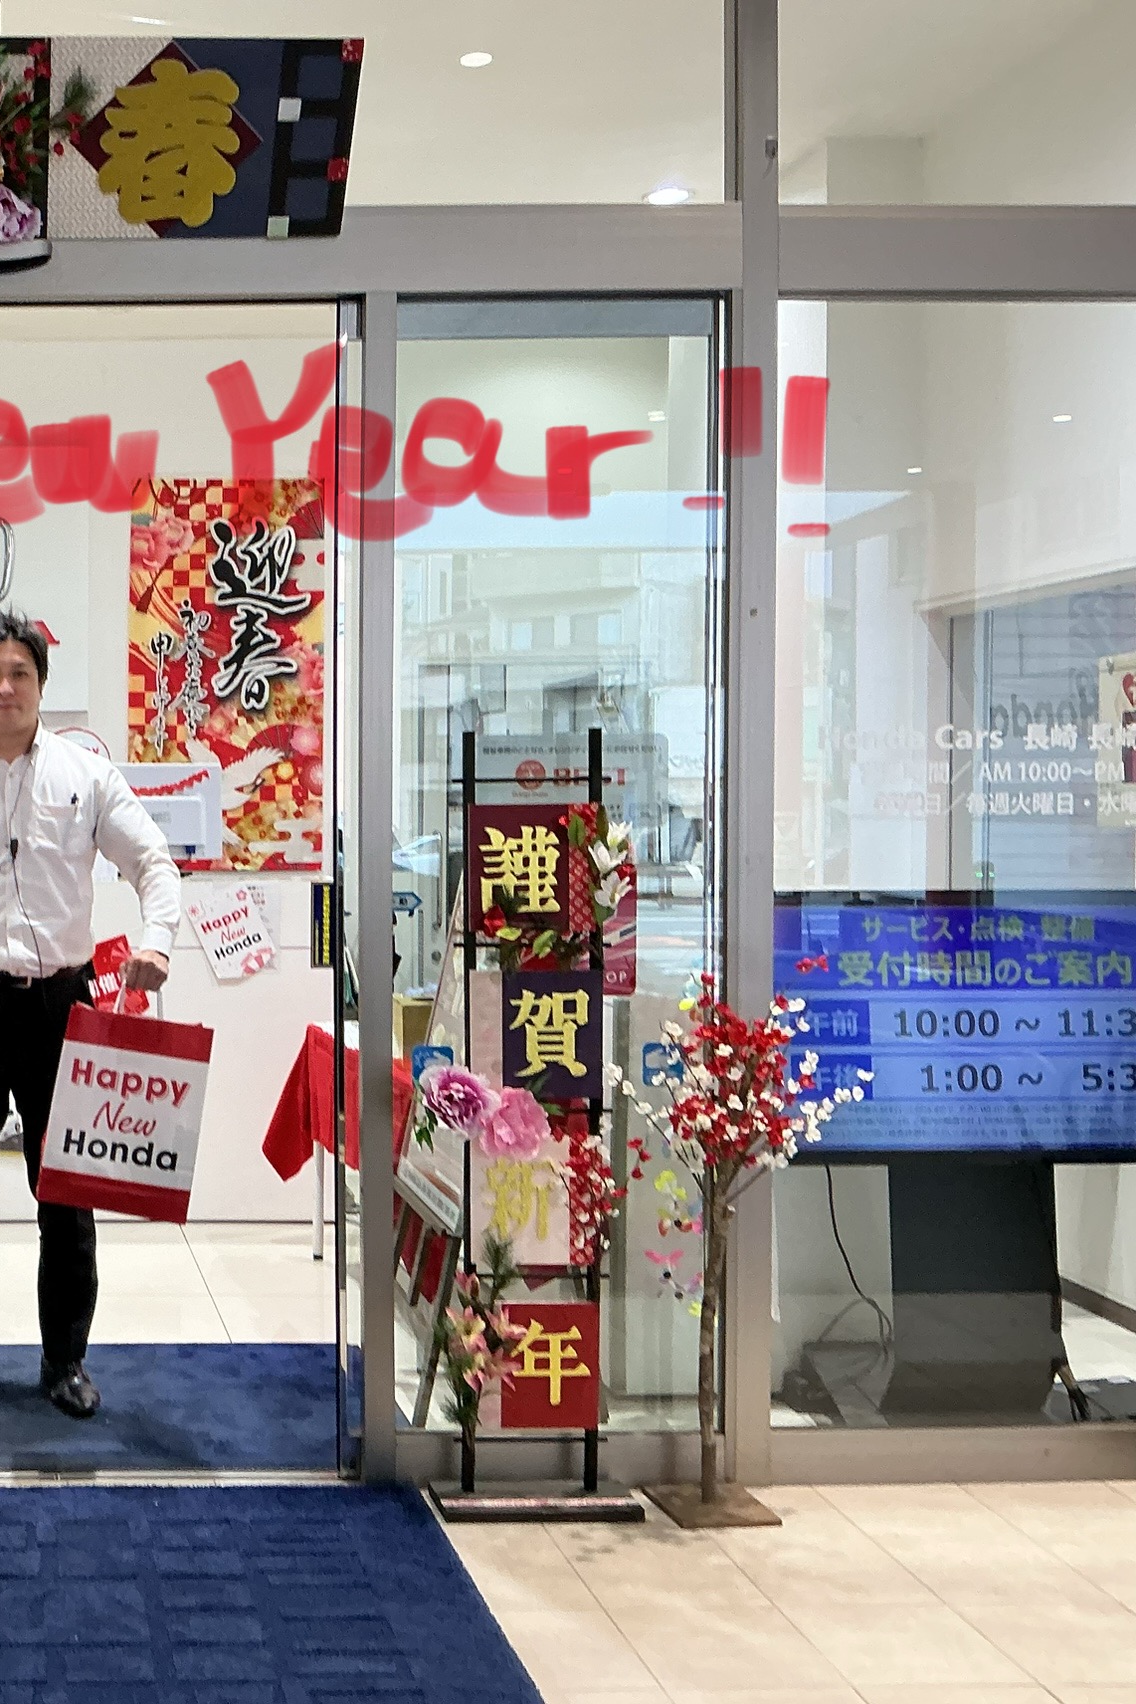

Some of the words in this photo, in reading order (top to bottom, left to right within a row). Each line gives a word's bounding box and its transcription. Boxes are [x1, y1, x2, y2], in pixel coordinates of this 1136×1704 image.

[100, 57, 240, 227] 春
[210, 518, 311, 711] 迎春
[935, 724, 1004, 750] Cars
[1024, 723, 1078, 750] 長崎
[979, 763, 1011, 782] AM
[201, 905, 250, 935] Happy
[220, 925, 246, 944] New
[214, 932, 262, 961] Honda
[838, 951, 1133, 987] 受付時間のご案内
[894, 1008, 1000, 1038] 10:00
[71, 1058, 191, 1109] Happy
[921, 1063, 1003, 1093] 1:00
[93, 1101, 157, 1137] New
[63, 1129, 179, 1171] Honda
